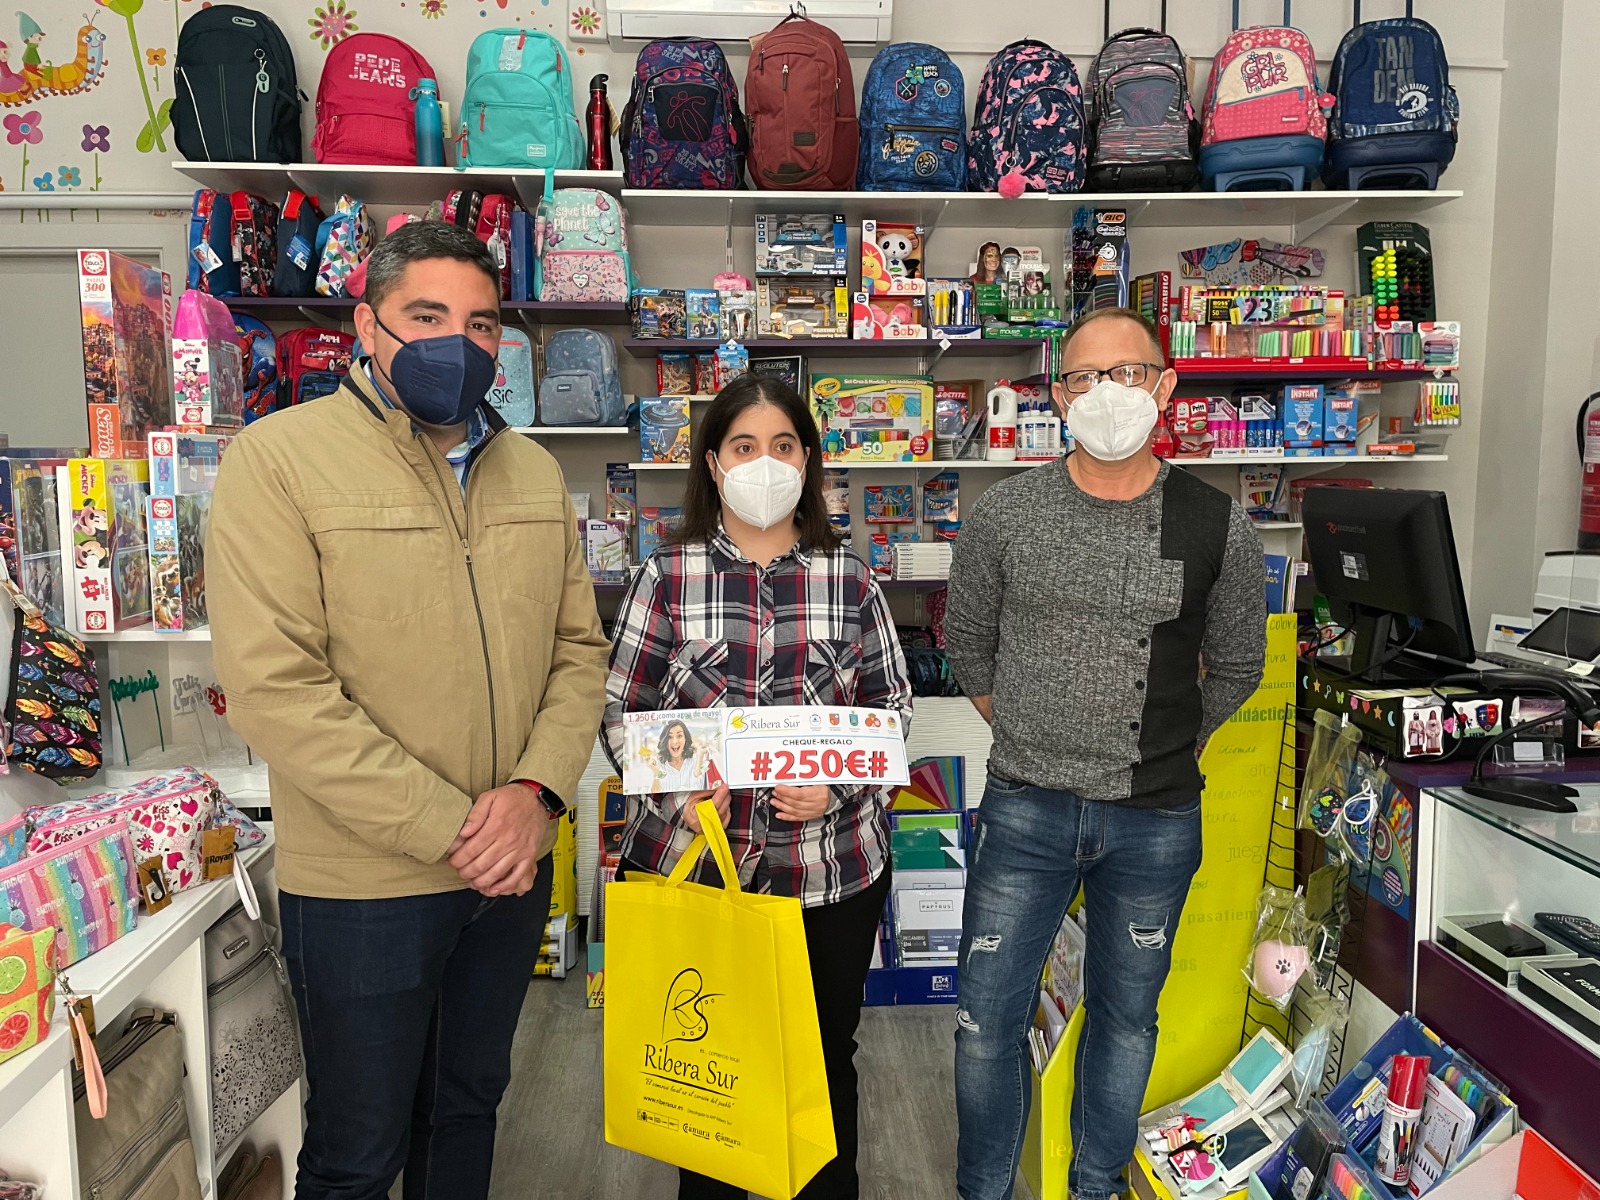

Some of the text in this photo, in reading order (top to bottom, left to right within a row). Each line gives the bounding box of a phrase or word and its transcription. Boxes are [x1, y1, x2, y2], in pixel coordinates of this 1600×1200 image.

[1375, 36, 1414, 69] TAN
[355, 53, 400, 73] PEPE
[1241, 52, 1286, 78] GRL
[348, 66, 406, 88] JEANS
[1246, 62, 1289, 93] PWR
[555, 204, 600, 217] save the
[84, 282, 106, 292] 300
[896, 281, 924, 293] Baby
[1243, 298, 1273, 322] 23
[318, 334, 340, 344] MPH
[892, 327, 920, 338] Baby
[818, 382, 837, 390] Crayola
[1291, 388, 1318, 399] INSTANT
[1332, 400, 1353, 409] INSTANT
[96, 408, 114, 458] Senior
[862, 441, 883, 454] 50
[80, 464, 88, 496] MICKEY
[1266, 652, 1286, 664] tura
[628, 713, 650, 722] 1.250
[650, 712, 656, 721] €
[656, 712, 676, 721] ¡como
[676, 713, 692, 722] agua
[701, 710, 722, 719] mayo!
[750, 716, 800, 730] Ribera Sur
[1218, 744, 1257, 755] idiomas
[750, 749, 888, 780] #250€#
[1204, 811, 1240, 824] tura
[56, 848, 82, 866] summer
[209, 853, 233, 864] Royan
[0, 874, 26, 890] ummer
[36, 899, 64, 916] summer
[644, 1044, 739, 1091] Ribera Sur
[670, 1086, 681, 1094] local
[643, 1095, 684, 1111] www.riberasur.es
[682, 1122, 710, 1138] Cámara
